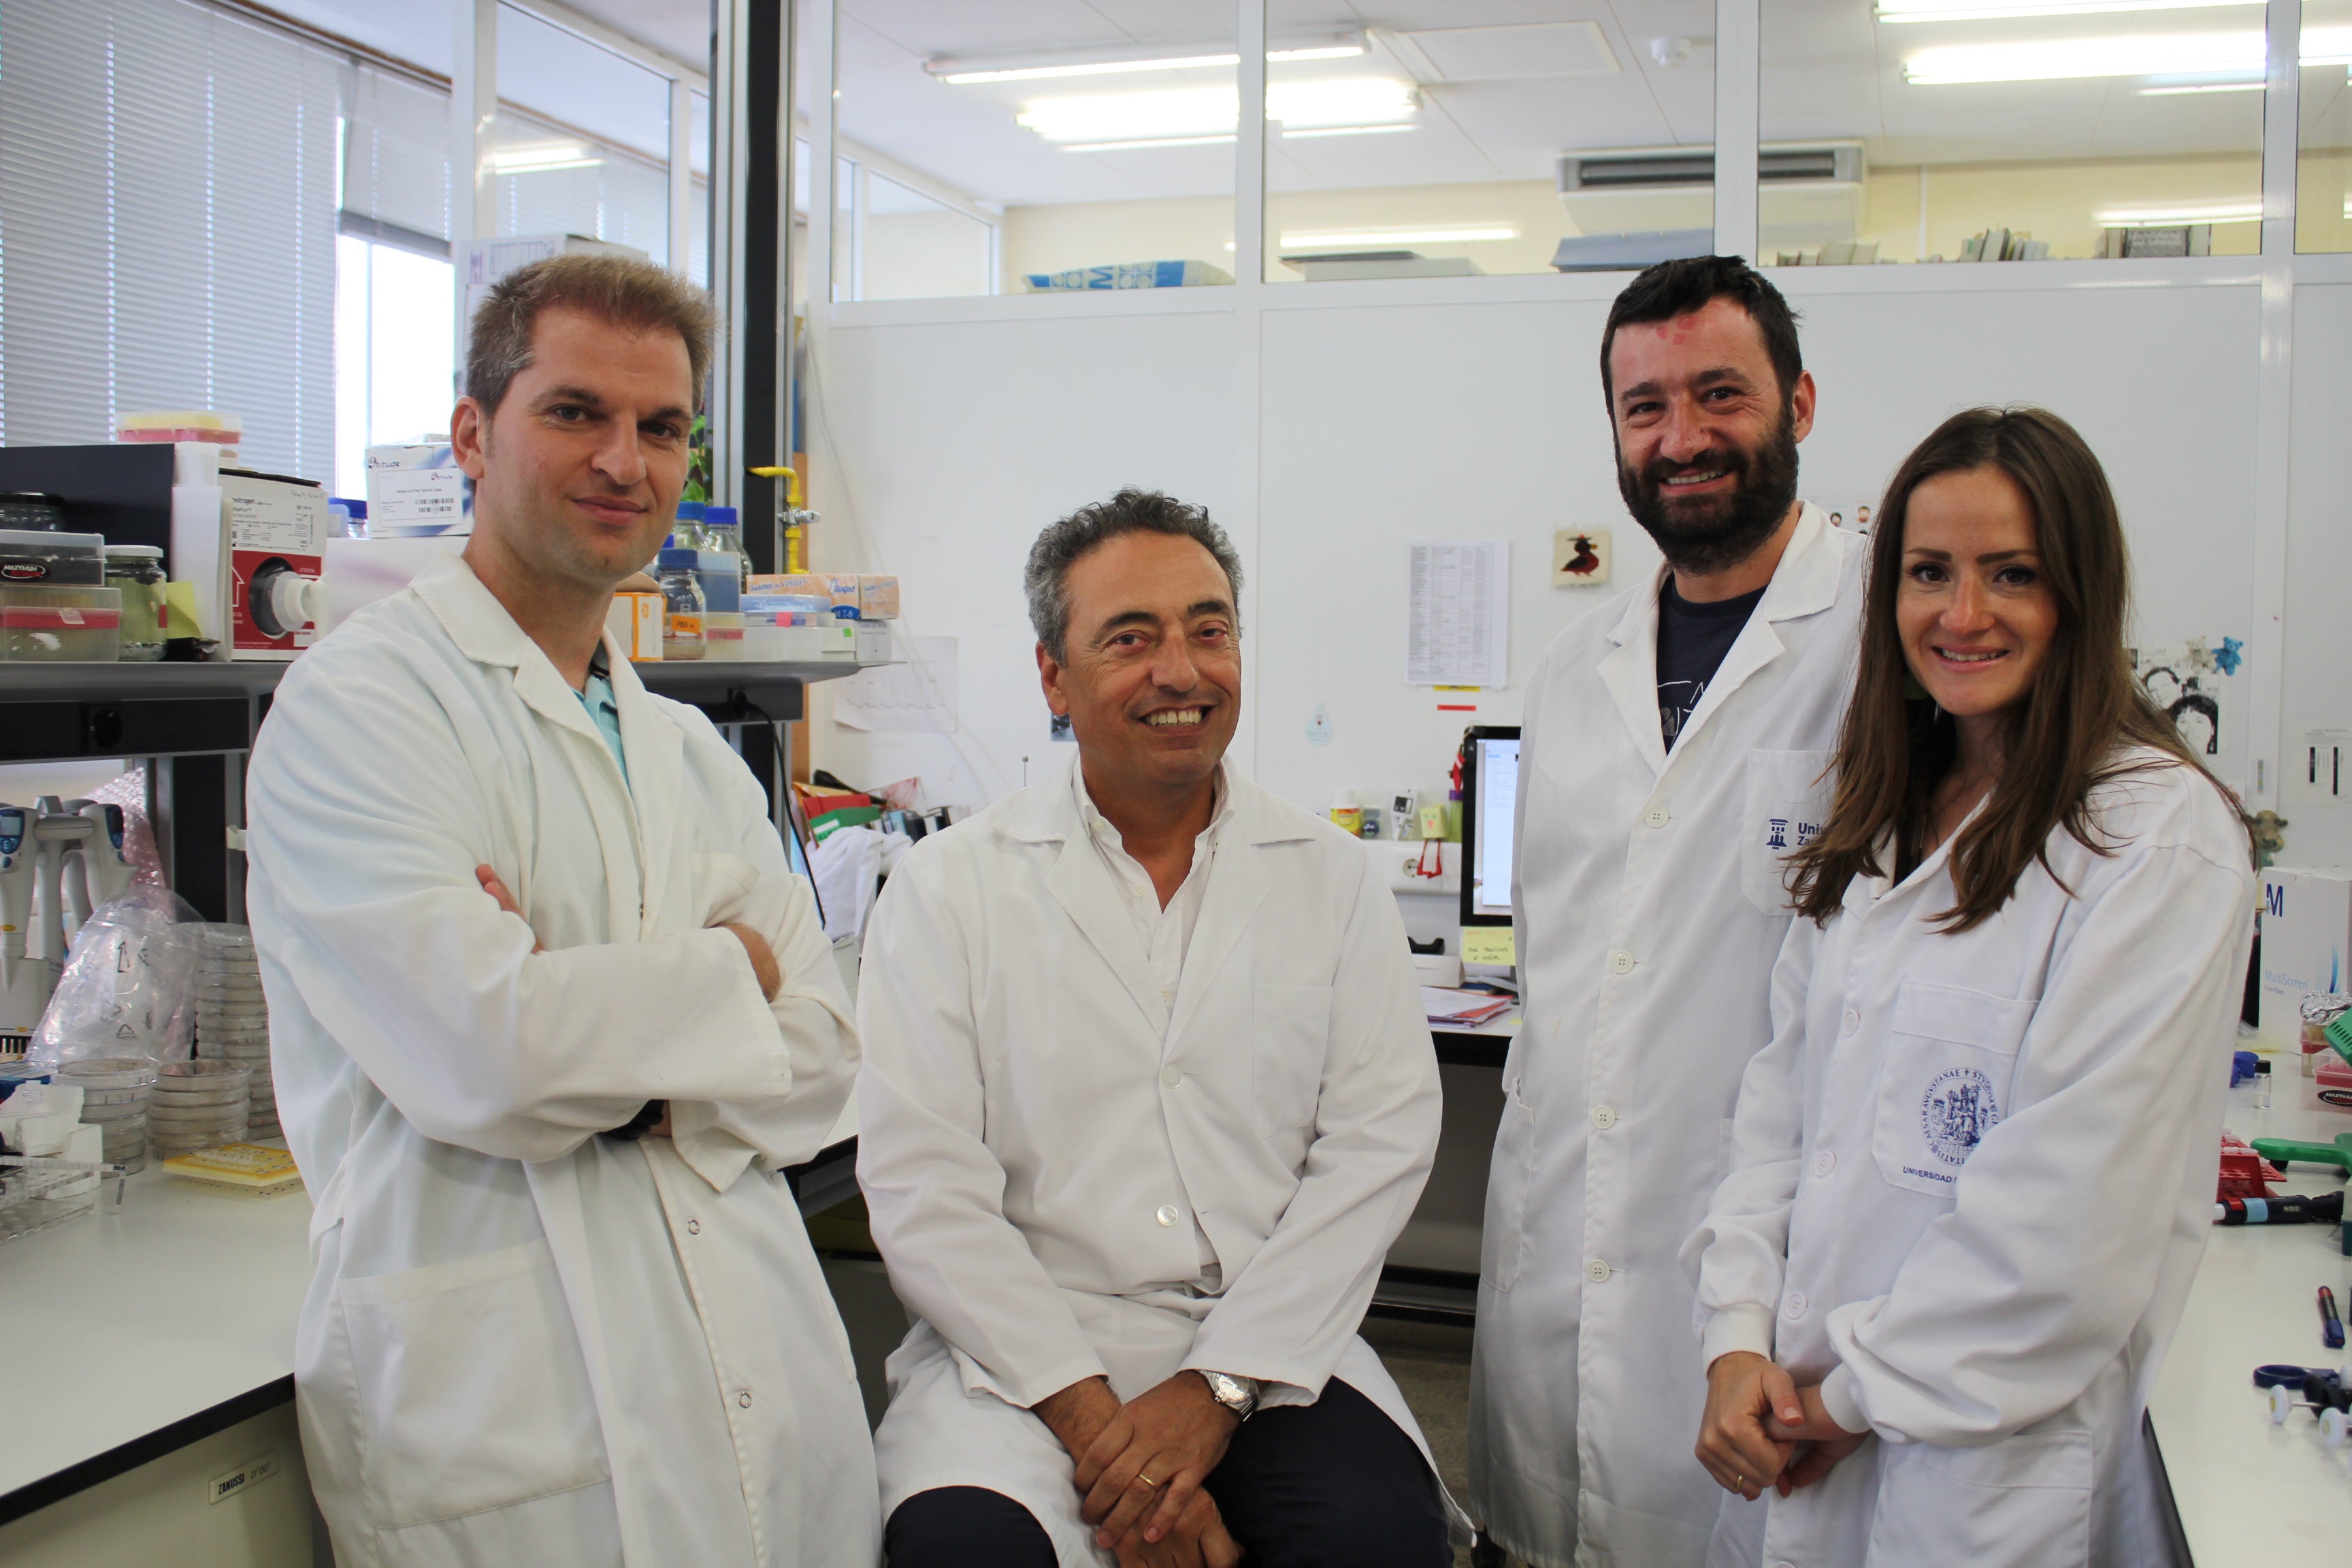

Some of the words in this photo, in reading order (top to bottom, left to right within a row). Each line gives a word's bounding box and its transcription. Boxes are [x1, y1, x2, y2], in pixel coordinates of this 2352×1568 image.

[749, 583, 773, 591] Guantes
[1903, 1166, 1953, 1183] UNIVERSIDAD
[218, 1472, 245, 1496] ZANUSSI
